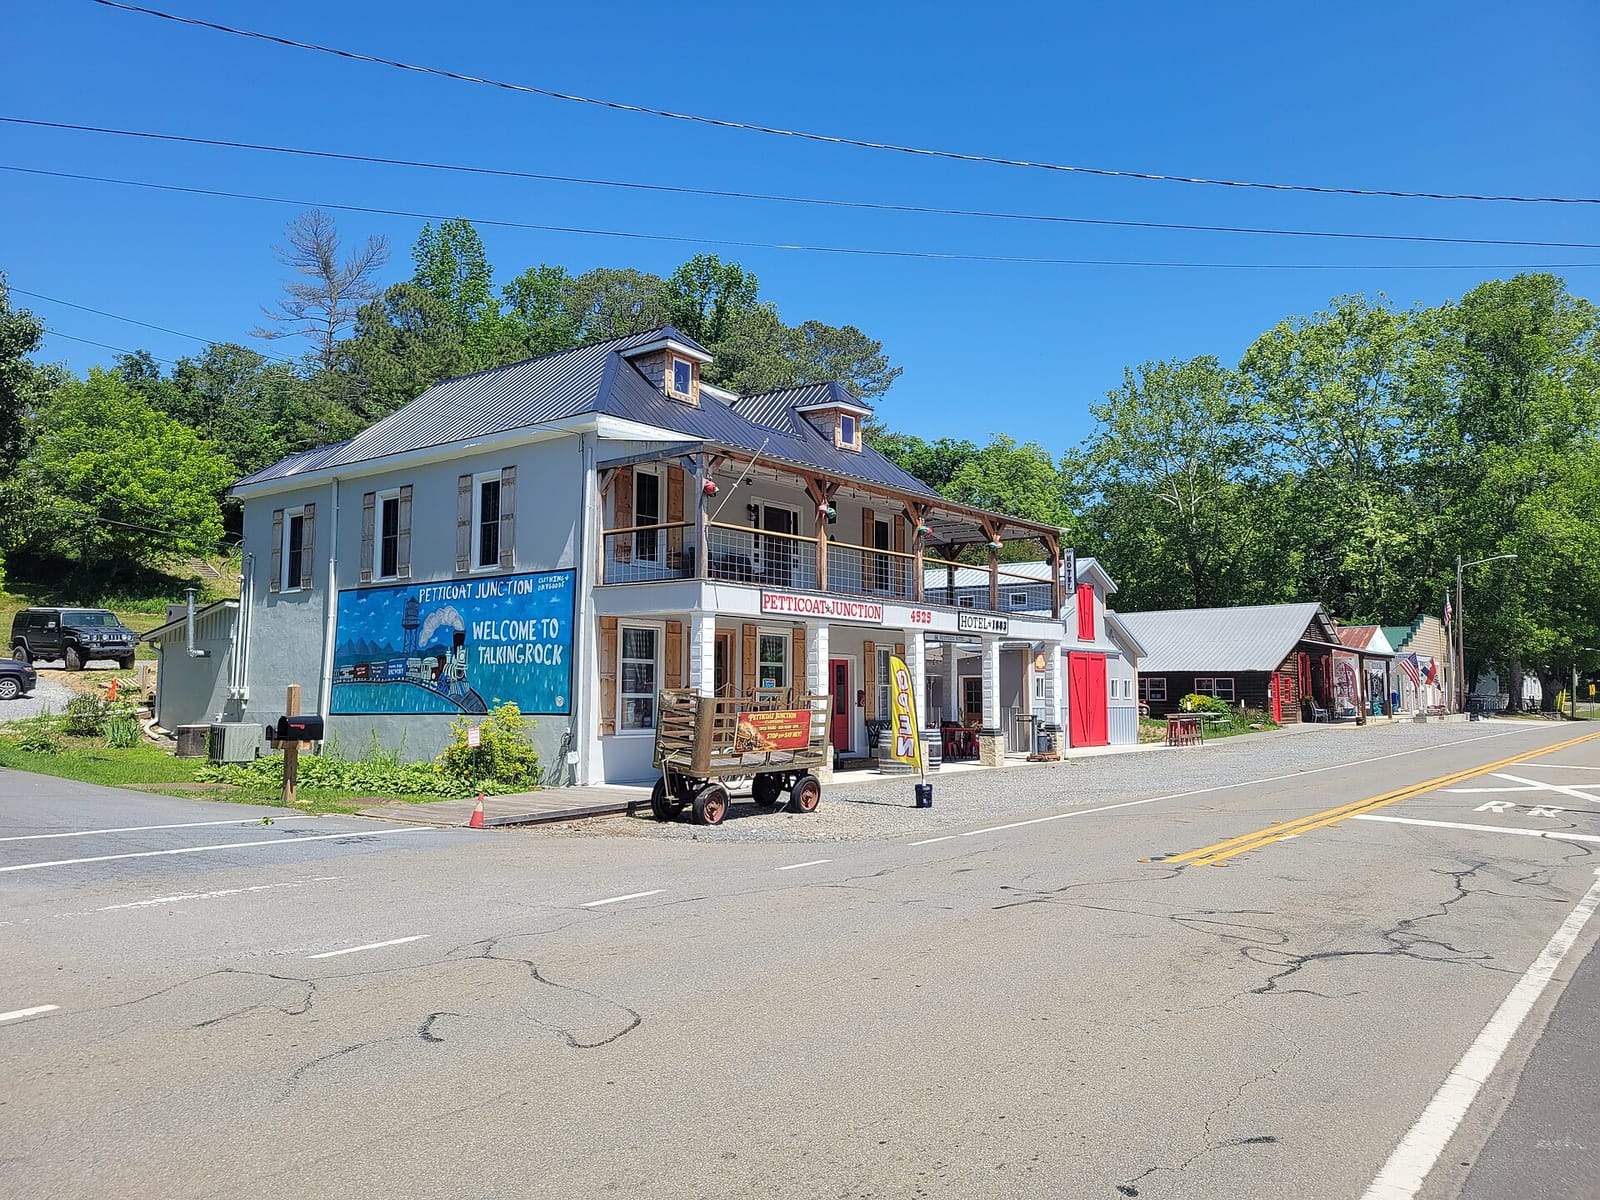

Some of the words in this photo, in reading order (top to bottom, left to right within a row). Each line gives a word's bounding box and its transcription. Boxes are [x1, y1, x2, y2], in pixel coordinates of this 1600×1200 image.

[418, 583, 473, 603] PETTICOAT
[475, 578, 533, 599] JUNCTION
[763, 593, 826, 614] PETTICOAT
[829, 601, 882, 620] JUNCTION
[910, 610, 932, 624] 4525
[472, 619, 537, 642] WELCOME
[541, 618, 559, 639] TO
[961, 615, 988, 630] HOTEL
[895, 669, 915, 758] OPEN
[1472, 800, 1516, 813] R
